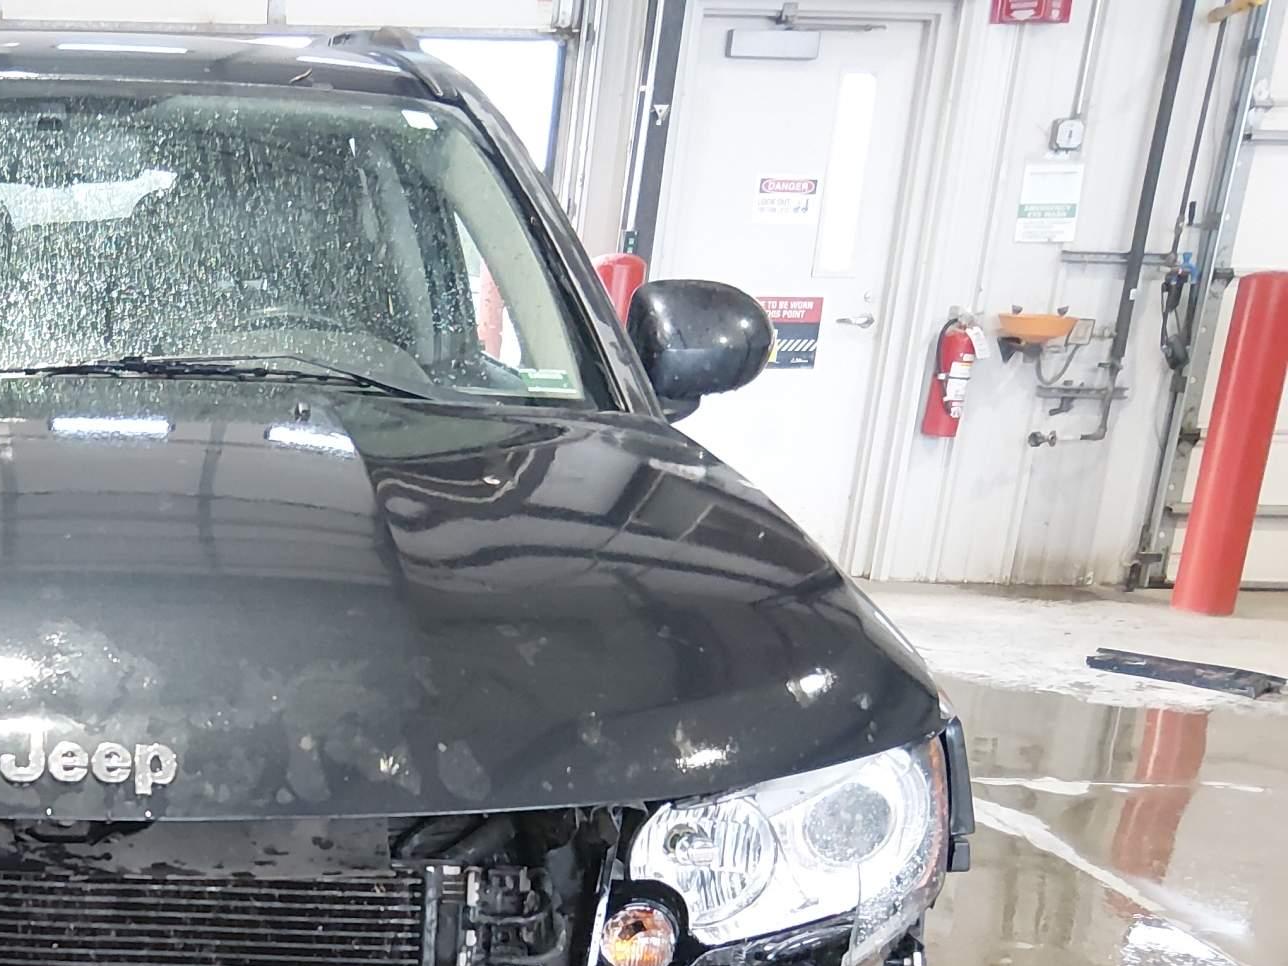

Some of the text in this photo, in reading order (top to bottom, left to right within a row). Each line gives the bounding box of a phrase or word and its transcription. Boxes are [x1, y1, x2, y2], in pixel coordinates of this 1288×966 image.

[767, 180, 809, 193] DANGER
[767, 301, 777, 309] TO
[778, 301, 789, 309] BE
[790, 301, 814, 310] WORN
[782, 310, 807, 319] POINT
[0, 729, 178, 796] Jeep
